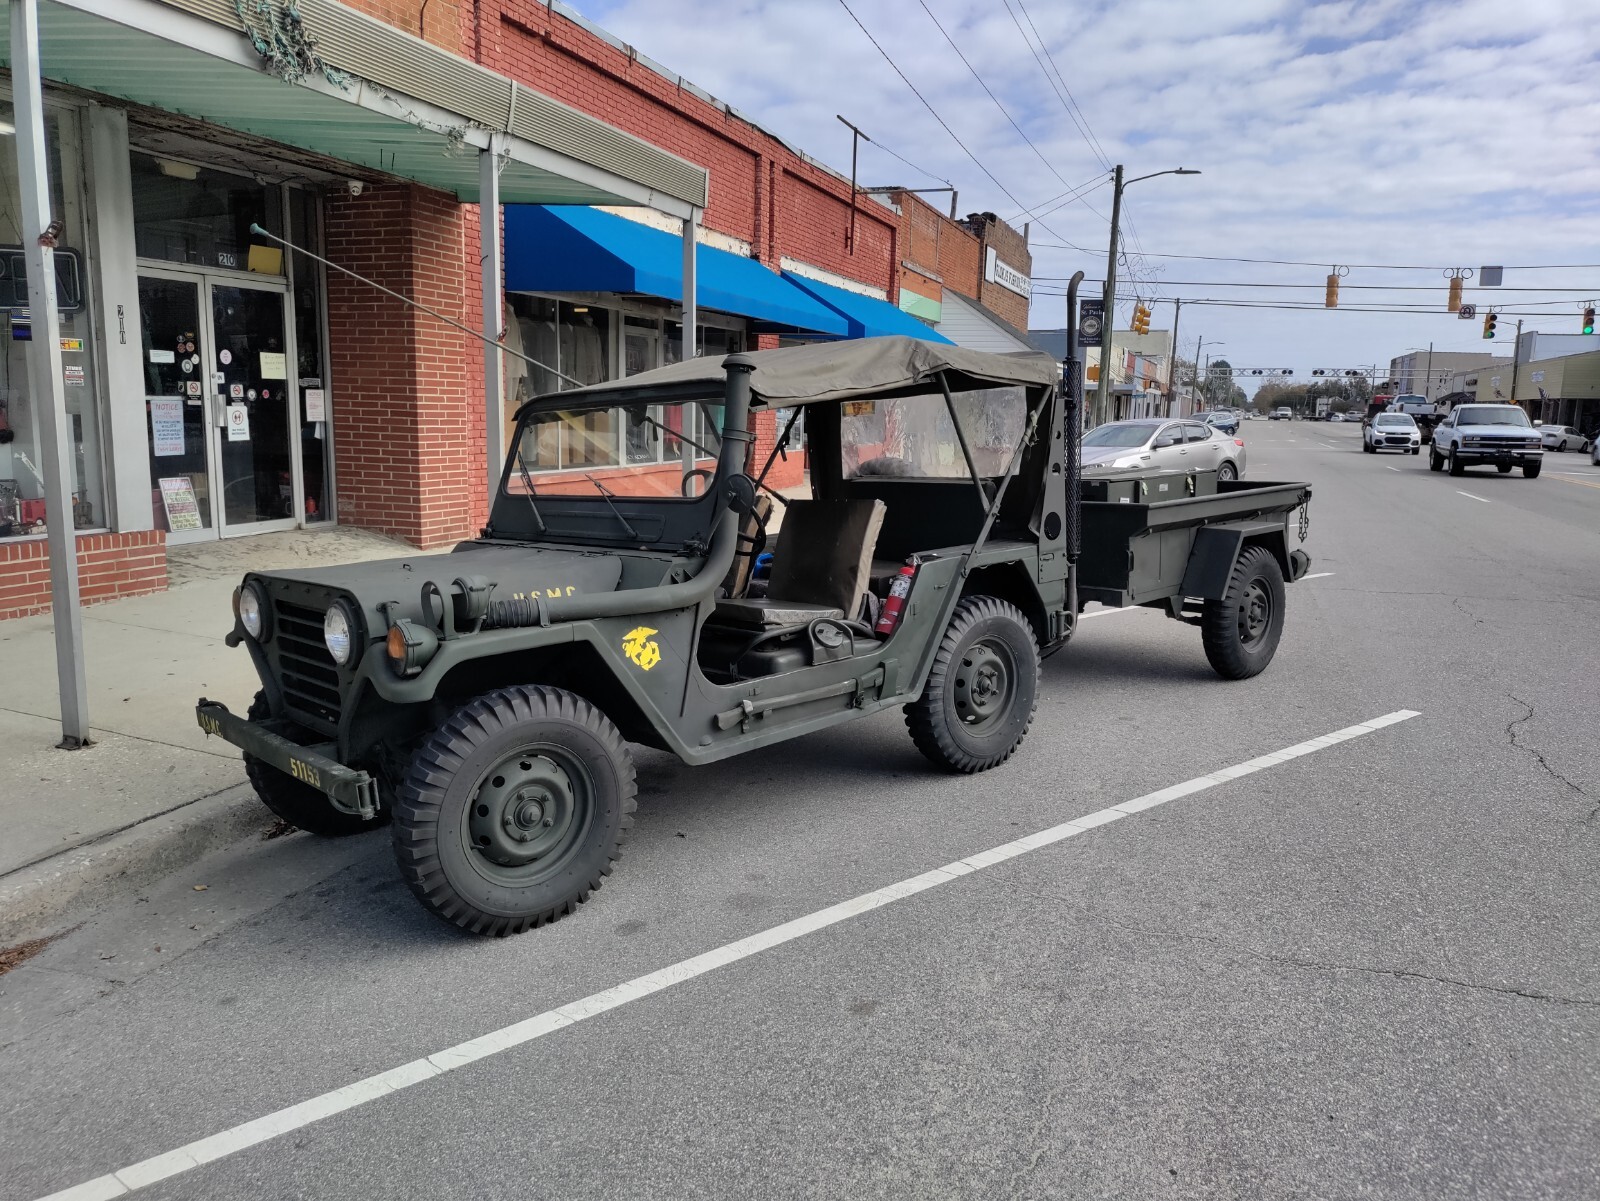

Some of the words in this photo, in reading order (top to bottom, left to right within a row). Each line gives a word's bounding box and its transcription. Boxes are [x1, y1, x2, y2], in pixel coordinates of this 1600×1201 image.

[220, 254, 235, 266] 210
[117, 305, 127, 345] 210
[155, 403, 179, 411] NOTICE
[290, 757, 321, 788] 51153
